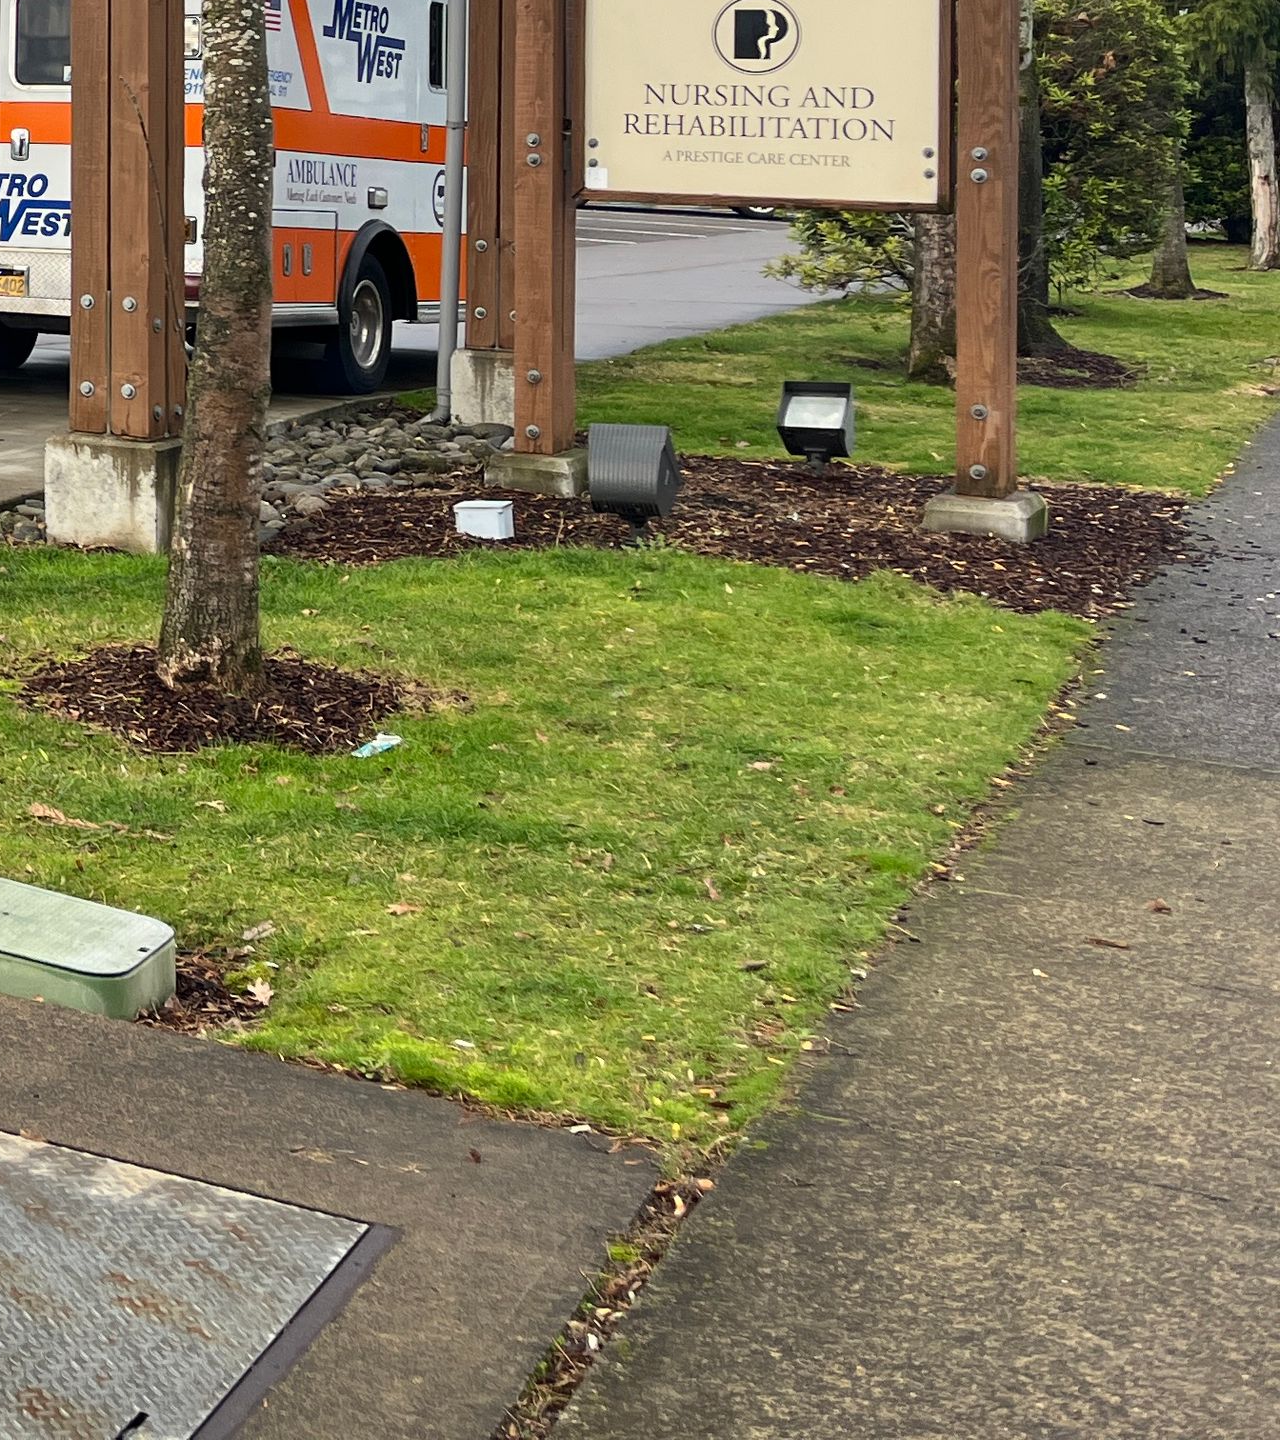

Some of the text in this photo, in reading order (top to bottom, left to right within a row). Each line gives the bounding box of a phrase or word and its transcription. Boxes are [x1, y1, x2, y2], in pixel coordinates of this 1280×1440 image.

[643, 83, 875, 109] NURSING AND
[623, 113, 896, 141] REHABILITATION
[663, 150, 851, 167] A PRESTIGE CARE CENTER
[286, 159, 358, 188] AMBULANCE
